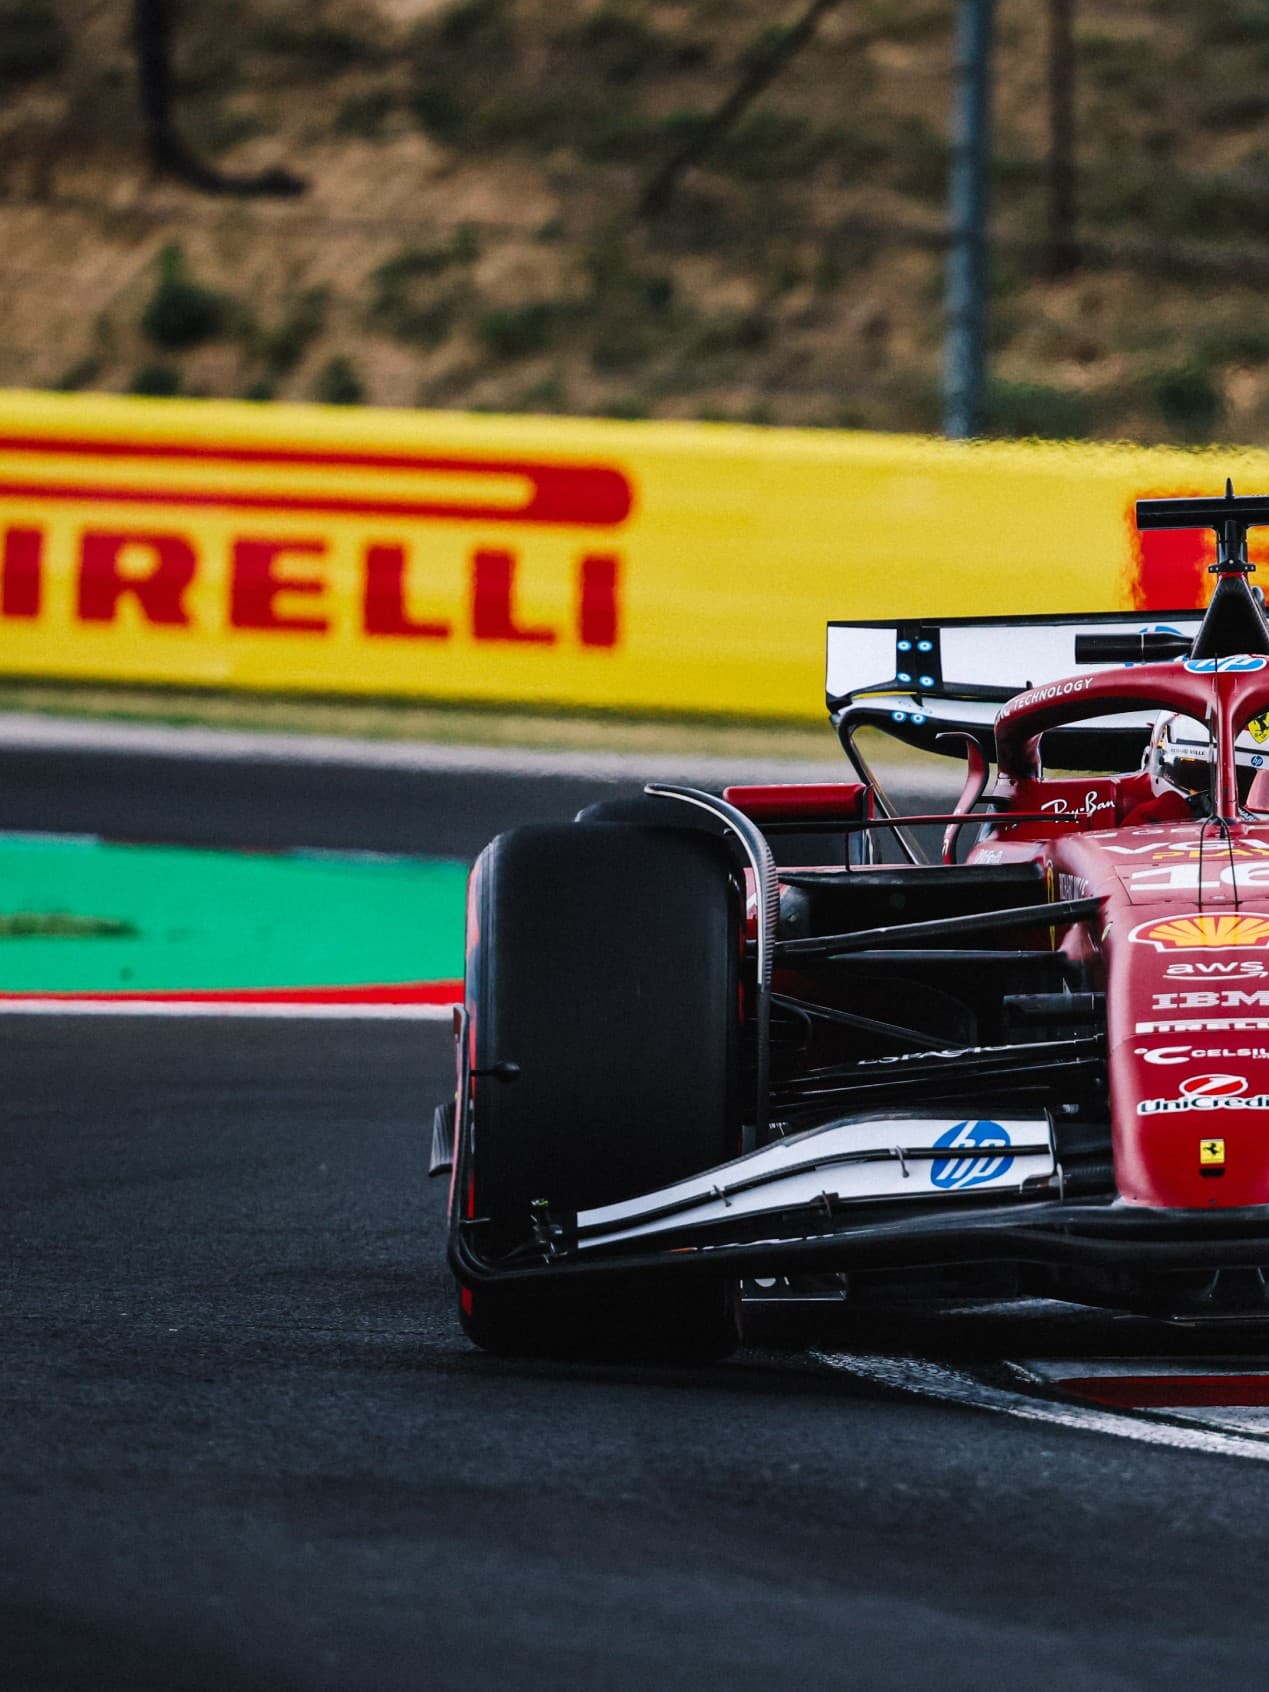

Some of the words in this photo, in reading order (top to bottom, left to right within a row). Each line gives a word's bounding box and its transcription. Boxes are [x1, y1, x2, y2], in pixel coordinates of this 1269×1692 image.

[1014, 676, 1093, 709] TECHNOLOGY
[1166, 961, 1265, 975] aws
[933, 1119, 1012, 1189] hp
